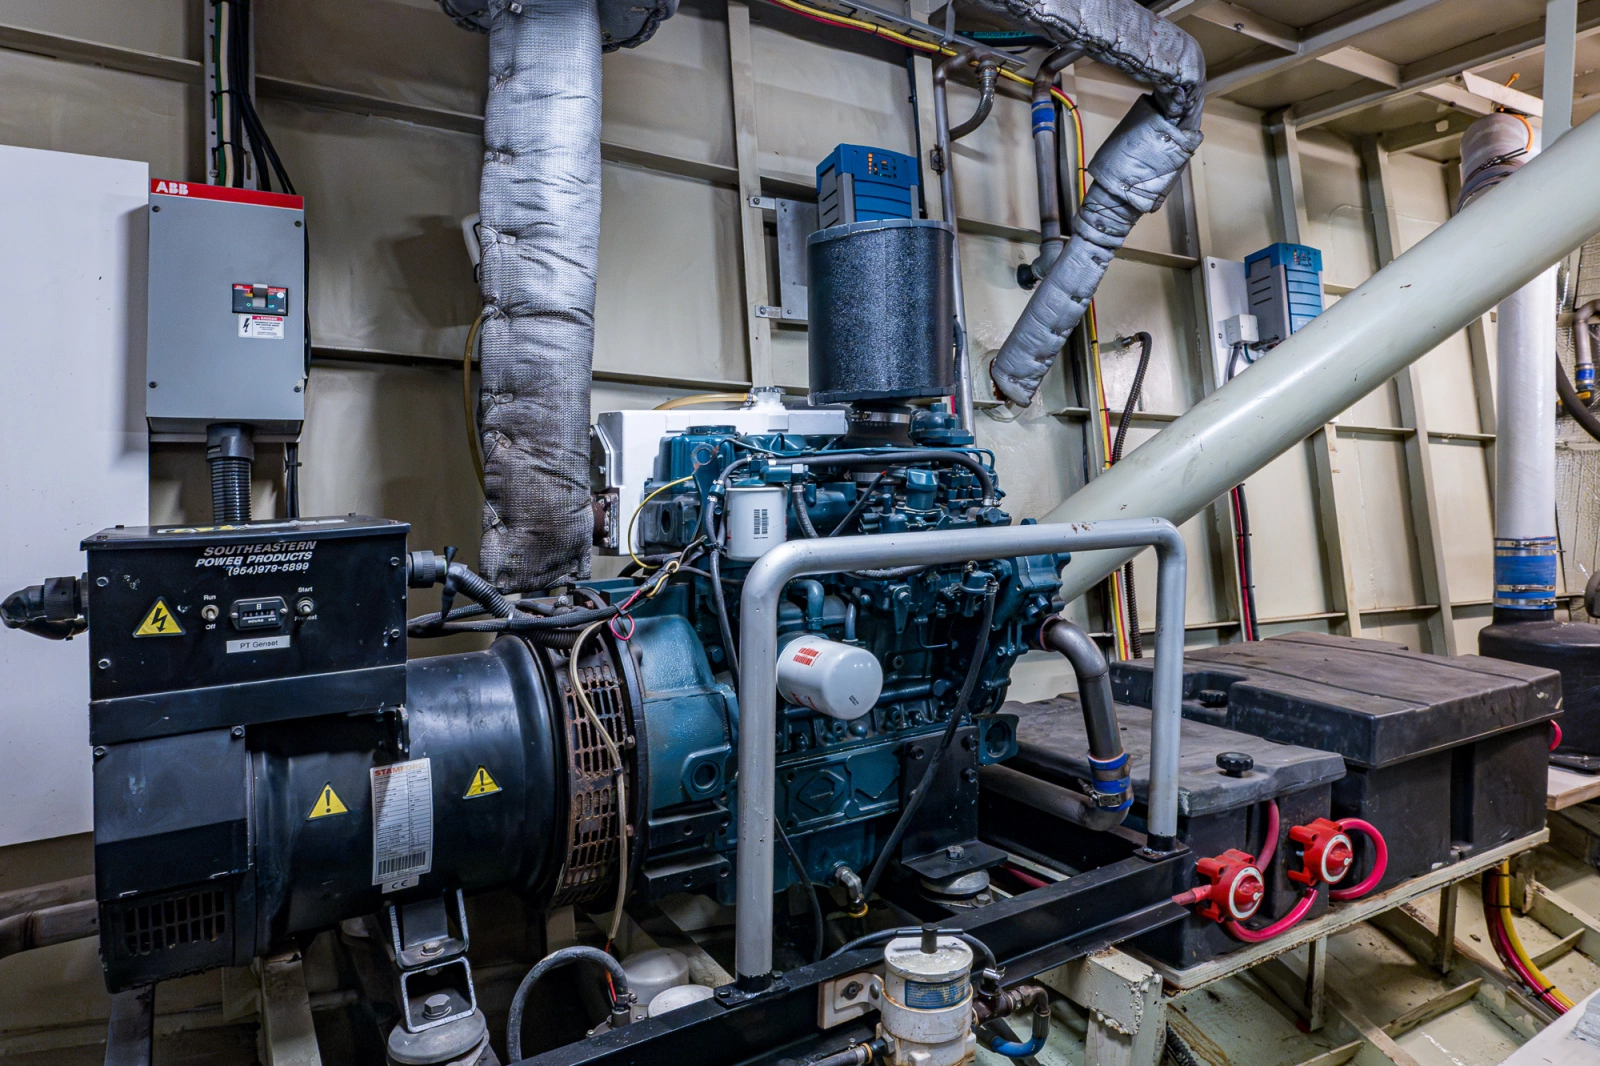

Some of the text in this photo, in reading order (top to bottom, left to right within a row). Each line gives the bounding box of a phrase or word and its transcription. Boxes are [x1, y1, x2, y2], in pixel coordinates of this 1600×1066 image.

[155, 181, 189, 195] ABB
[203, 541, 317, 556] SOUTHEASTERN
[195, 551, 313, 567] POWER PRODUCTS
[227, 562, 309, 576] (954)979-5899
[240, 640, 279, 650] PT Genset
[375, 763, 425, 777] STAMFORD
